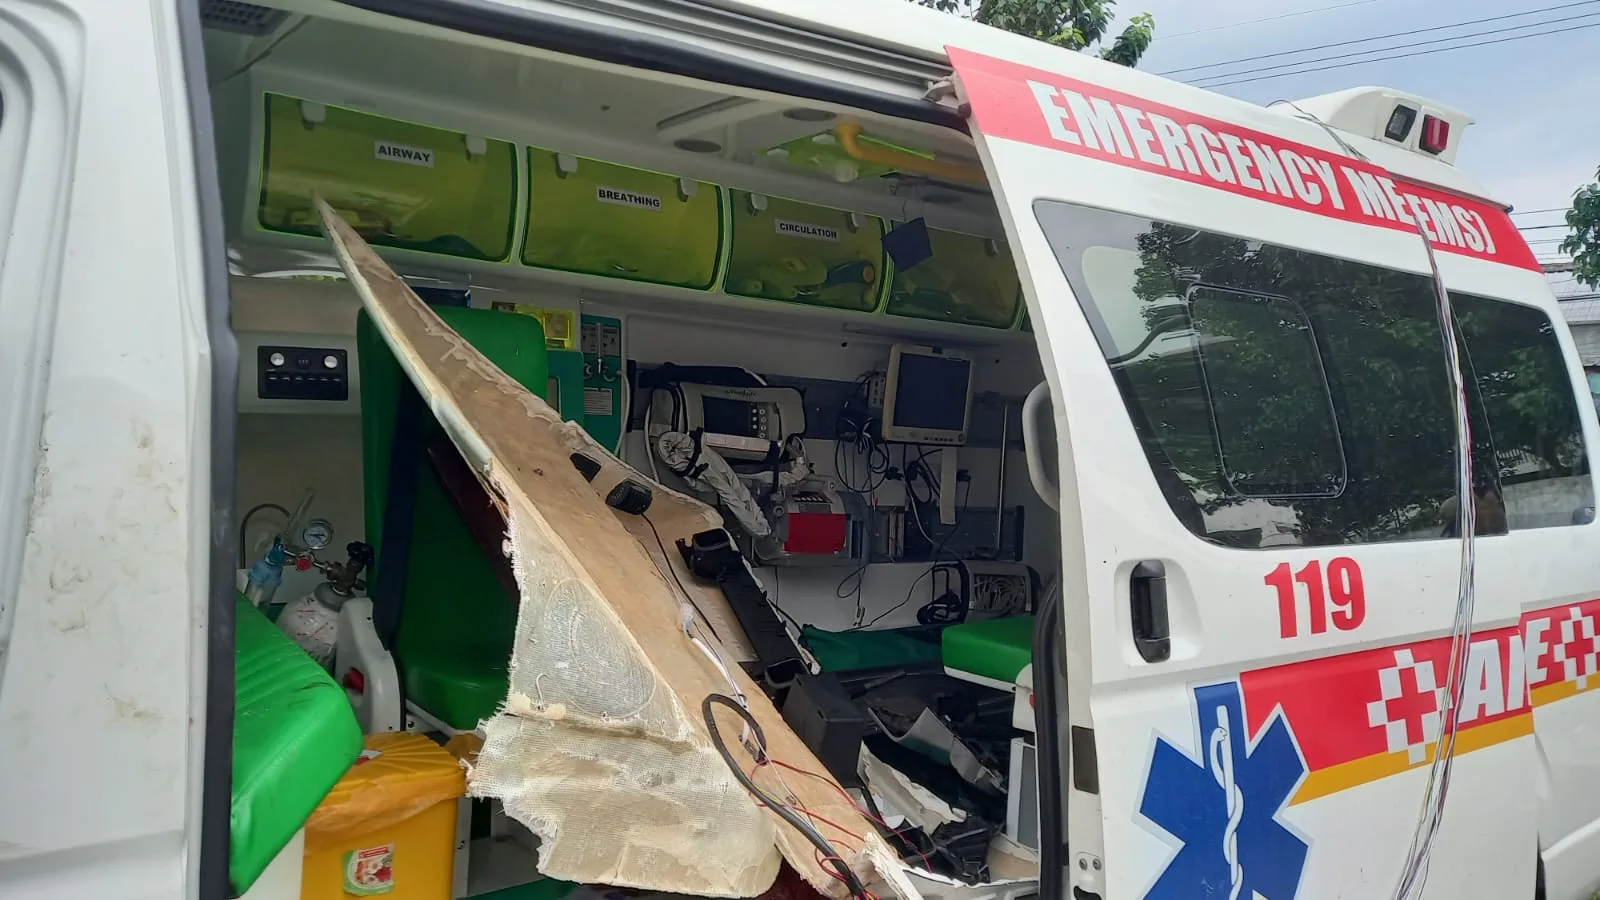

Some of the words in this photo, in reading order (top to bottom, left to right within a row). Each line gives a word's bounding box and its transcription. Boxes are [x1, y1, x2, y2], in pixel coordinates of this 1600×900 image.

[377, 144, 431, 163] AIRWAY
[1026, 79, 1345, 211] EMERGENCY
[598, 188, 661, 208] BREATHING
[779, 222, 838, 239] CIRCULATION
[1264, 556, 1366, 639] 119
